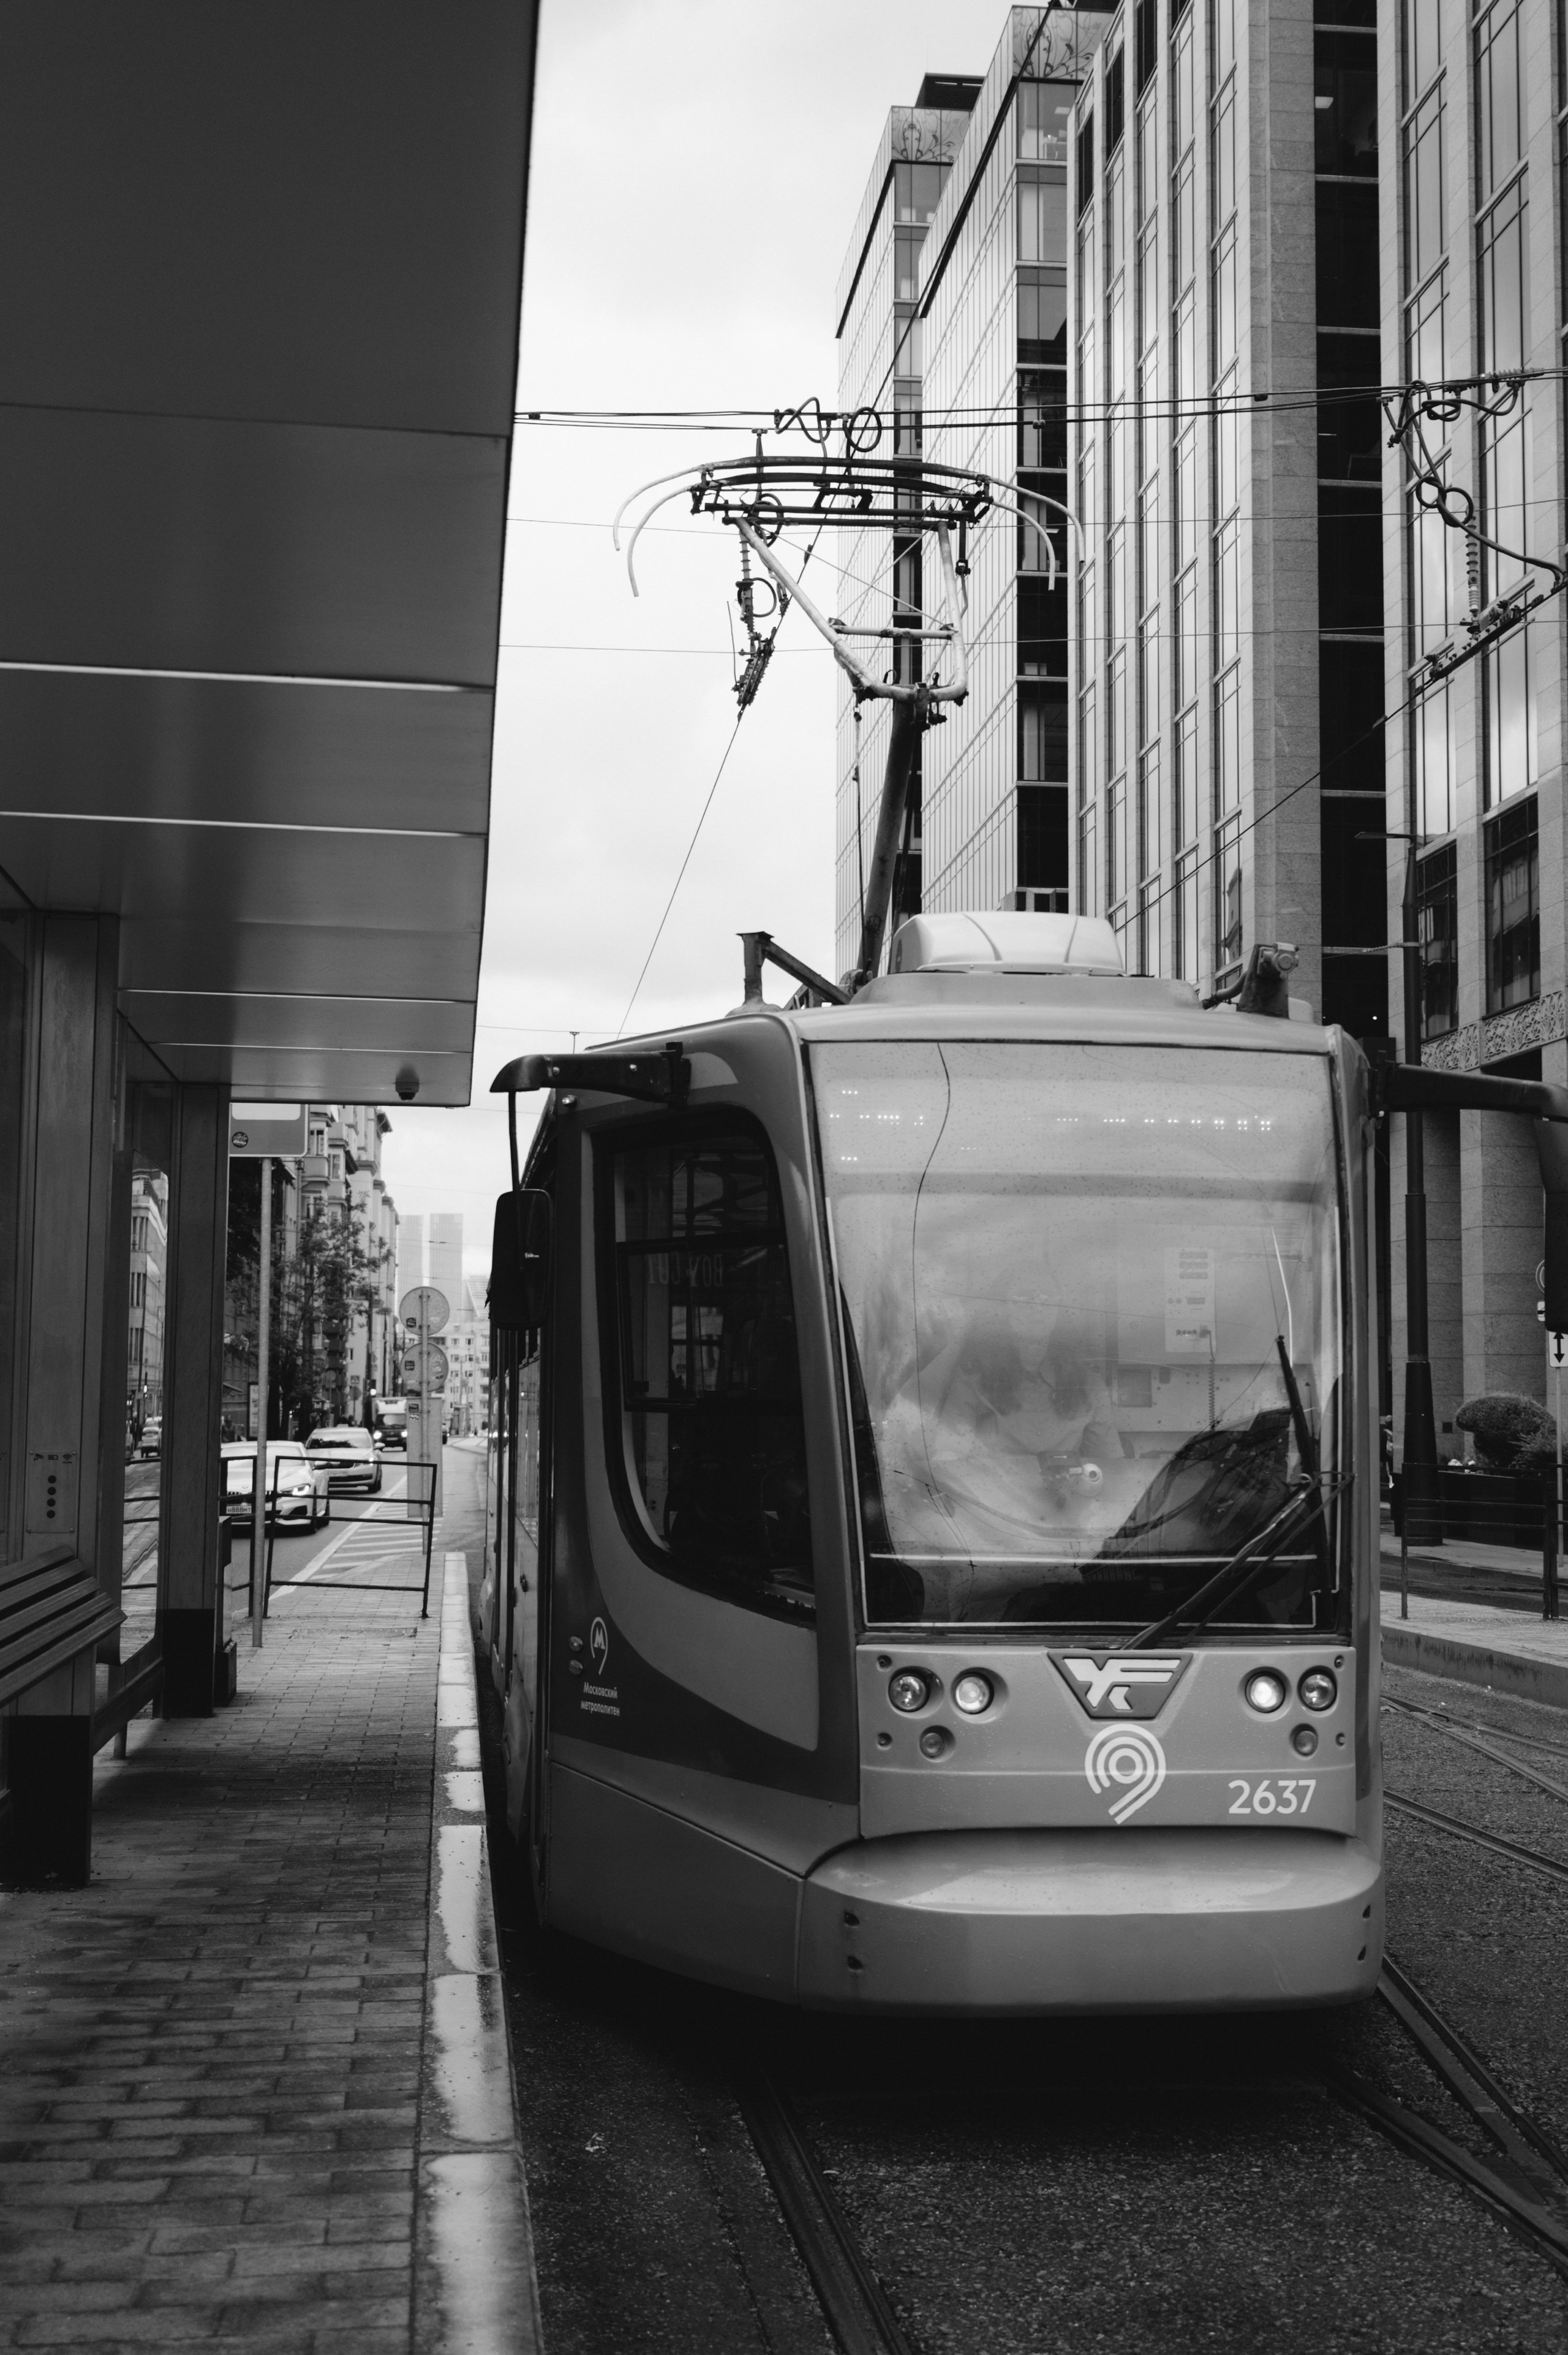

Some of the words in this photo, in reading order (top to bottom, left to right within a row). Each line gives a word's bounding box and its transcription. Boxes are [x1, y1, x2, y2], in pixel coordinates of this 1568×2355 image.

[583, 1682, 618, 1699] Московский
[581, 1701, 620, 1716] метрополитен
[1228, 1779, 1317, 1815] 2637
